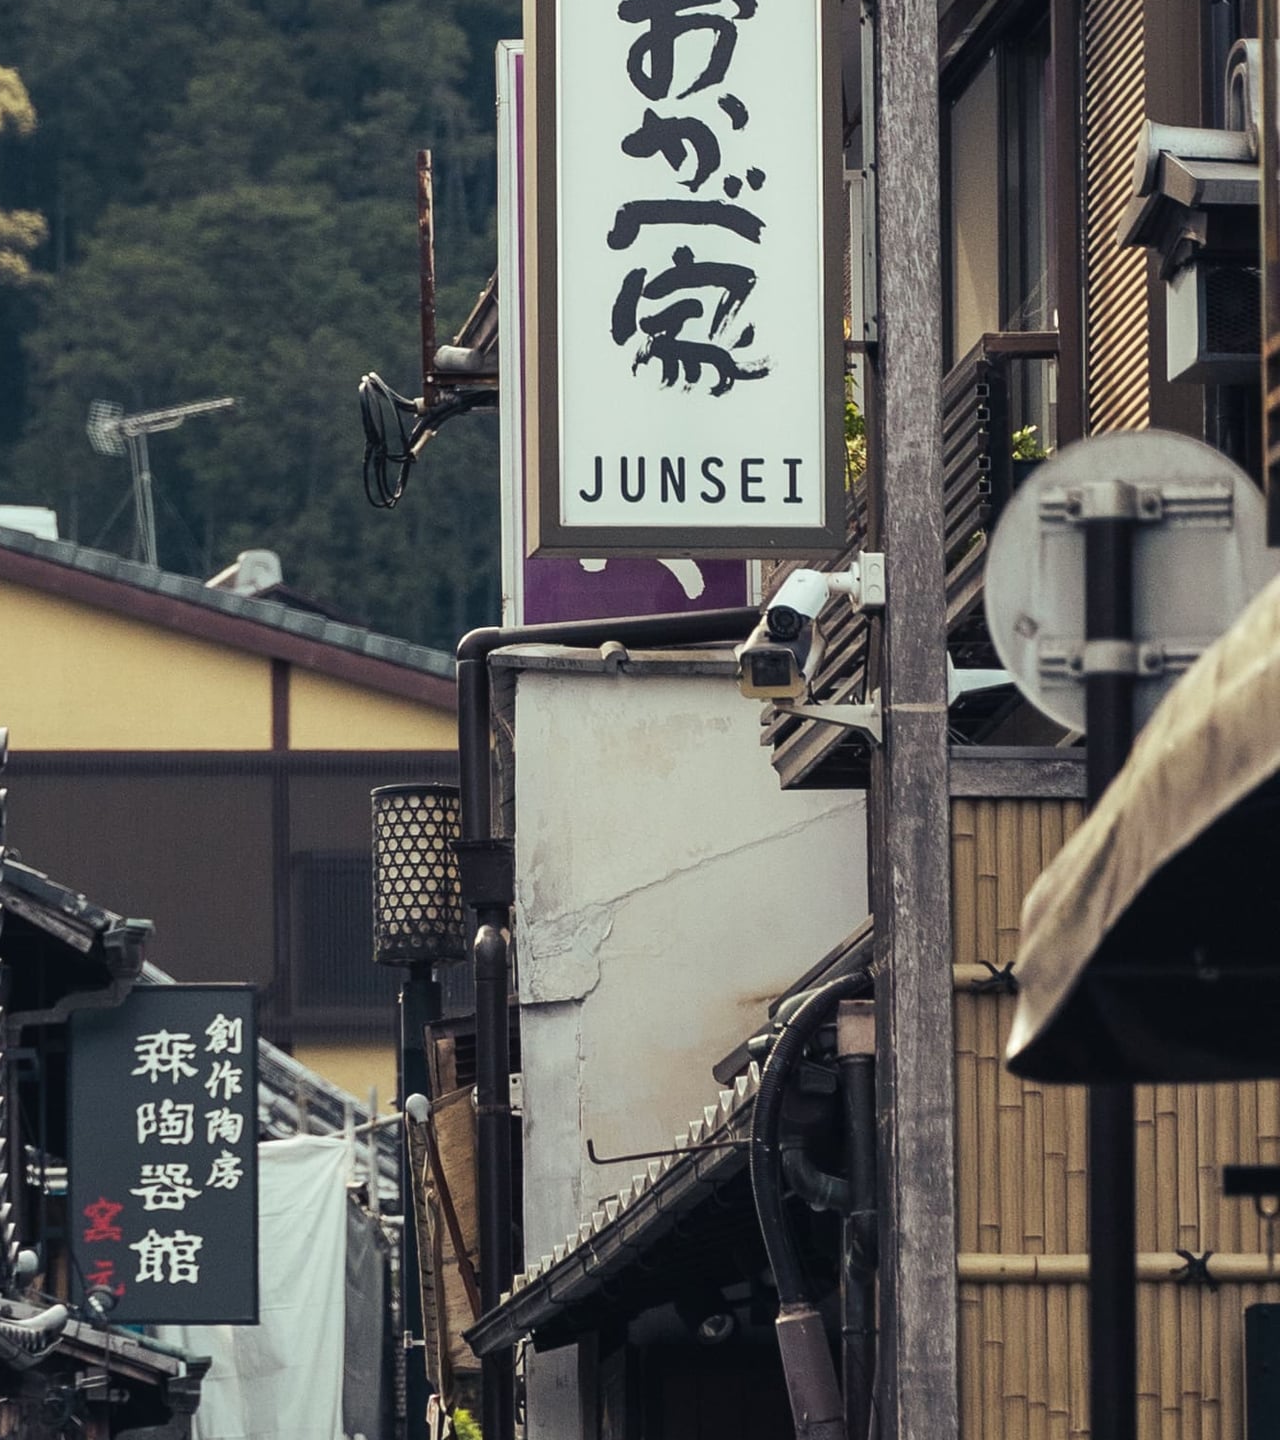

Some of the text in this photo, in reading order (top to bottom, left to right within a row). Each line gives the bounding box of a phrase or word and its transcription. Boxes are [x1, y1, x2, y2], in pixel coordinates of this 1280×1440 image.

[579, 455, 803, 504] JUNSEI
[130, 1028, 204, 1285] 森陶器館
[204, 1013, 244, 1191] 創作陶房
